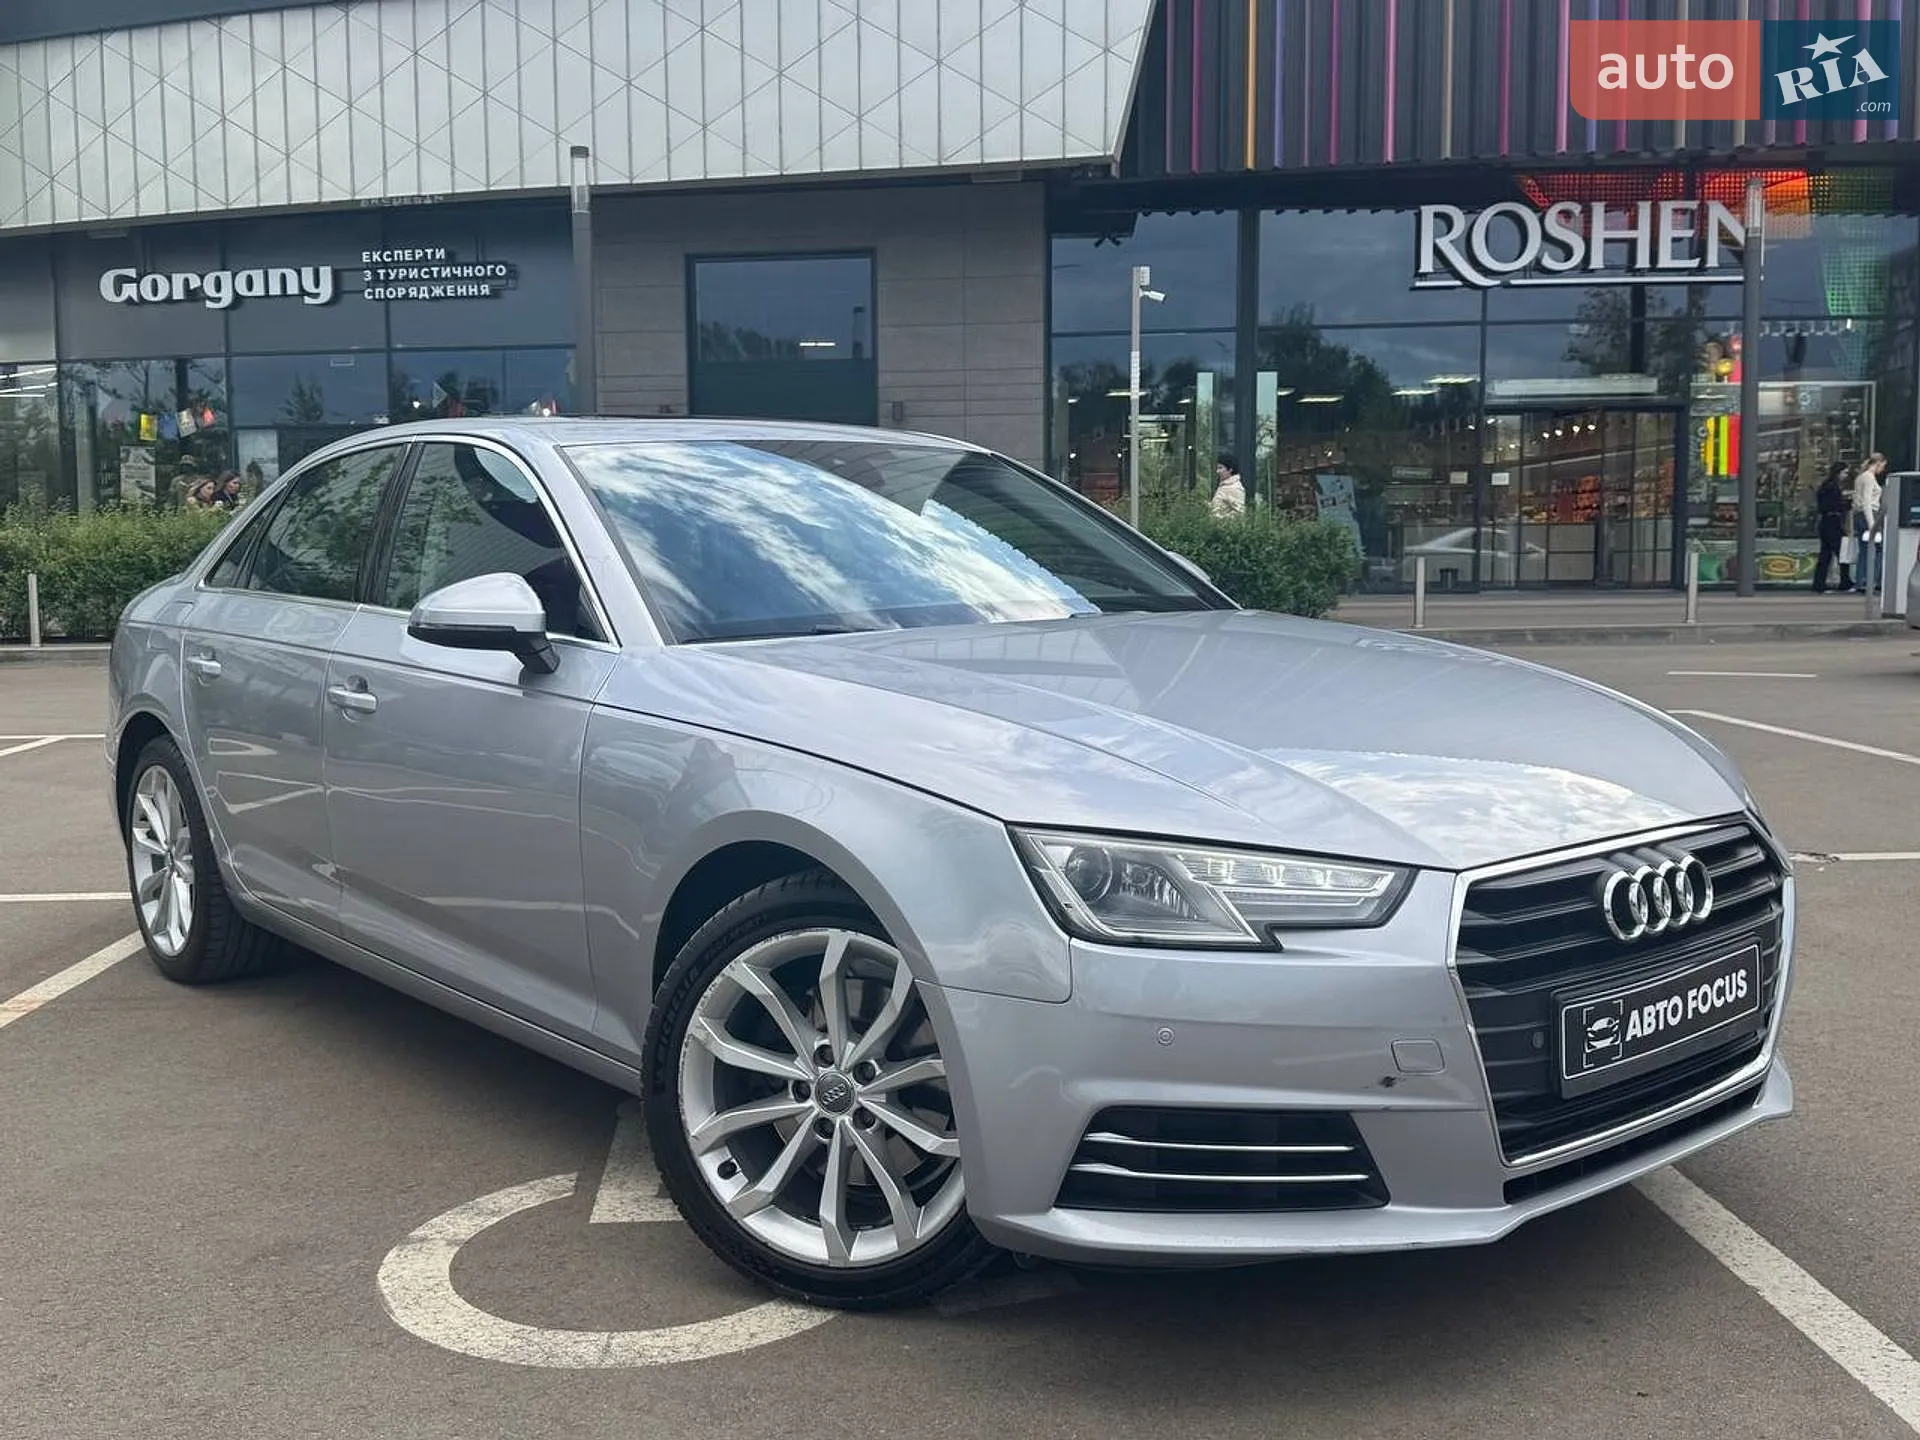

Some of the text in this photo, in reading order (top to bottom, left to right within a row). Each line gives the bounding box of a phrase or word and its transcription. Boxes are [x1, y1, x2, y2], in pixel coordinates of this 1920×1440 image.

[361, 247, 446, 263] ЕКСПЕРТИ
[1417, 200, 1765, 288] ROSHEN
[99, 265, 333, 309] Gorgany
[377, 264, 507, 281] ТУРИСТИЧНОГО
[363, 284, 490, 300] СПОРЯДЖЕННЯ
[1687, 969, 1747, 1020] FOCUS
